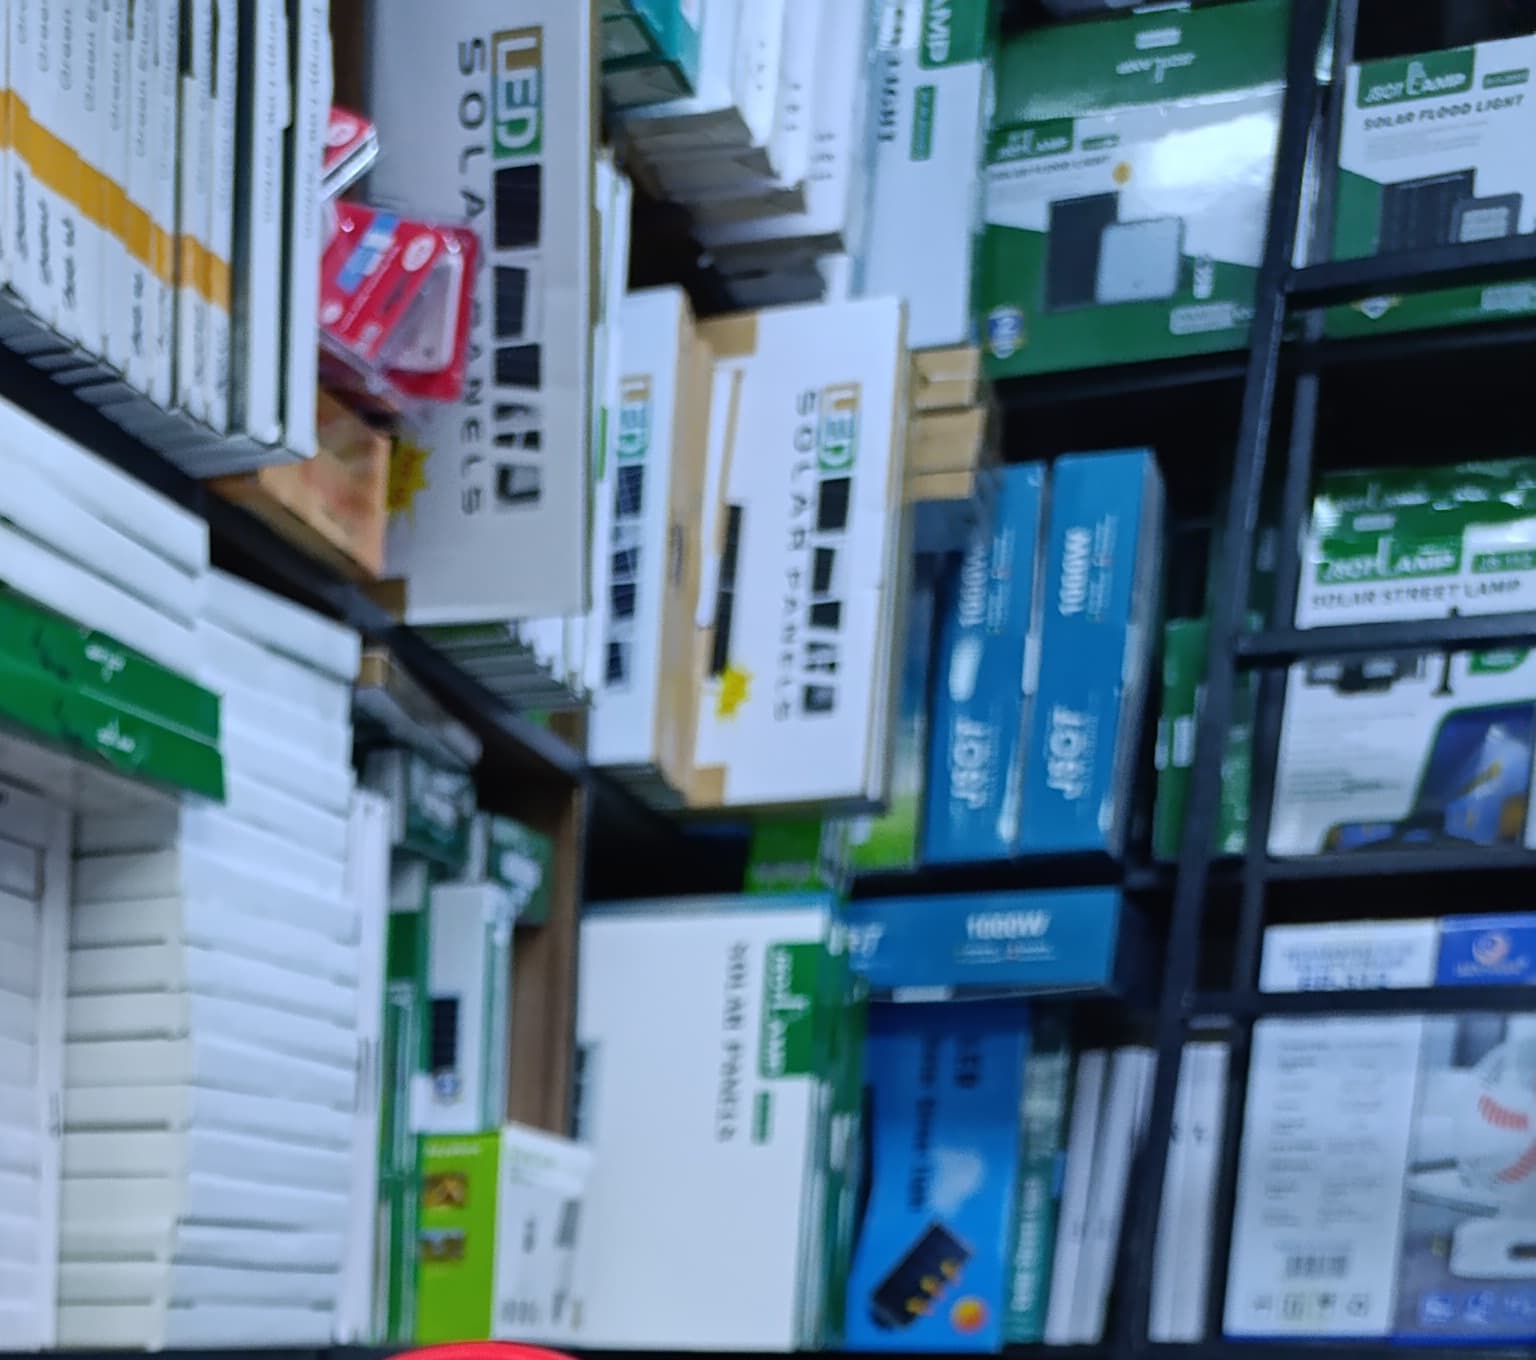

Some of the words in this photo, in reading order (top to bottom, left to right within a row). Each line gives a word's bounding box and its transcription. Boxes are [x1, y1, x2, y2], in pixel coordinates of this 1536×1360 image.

[457, 37, 487, 268] SOLA
[493, 26, 543, 158] LED
[818, 382, 862, 472] LED
